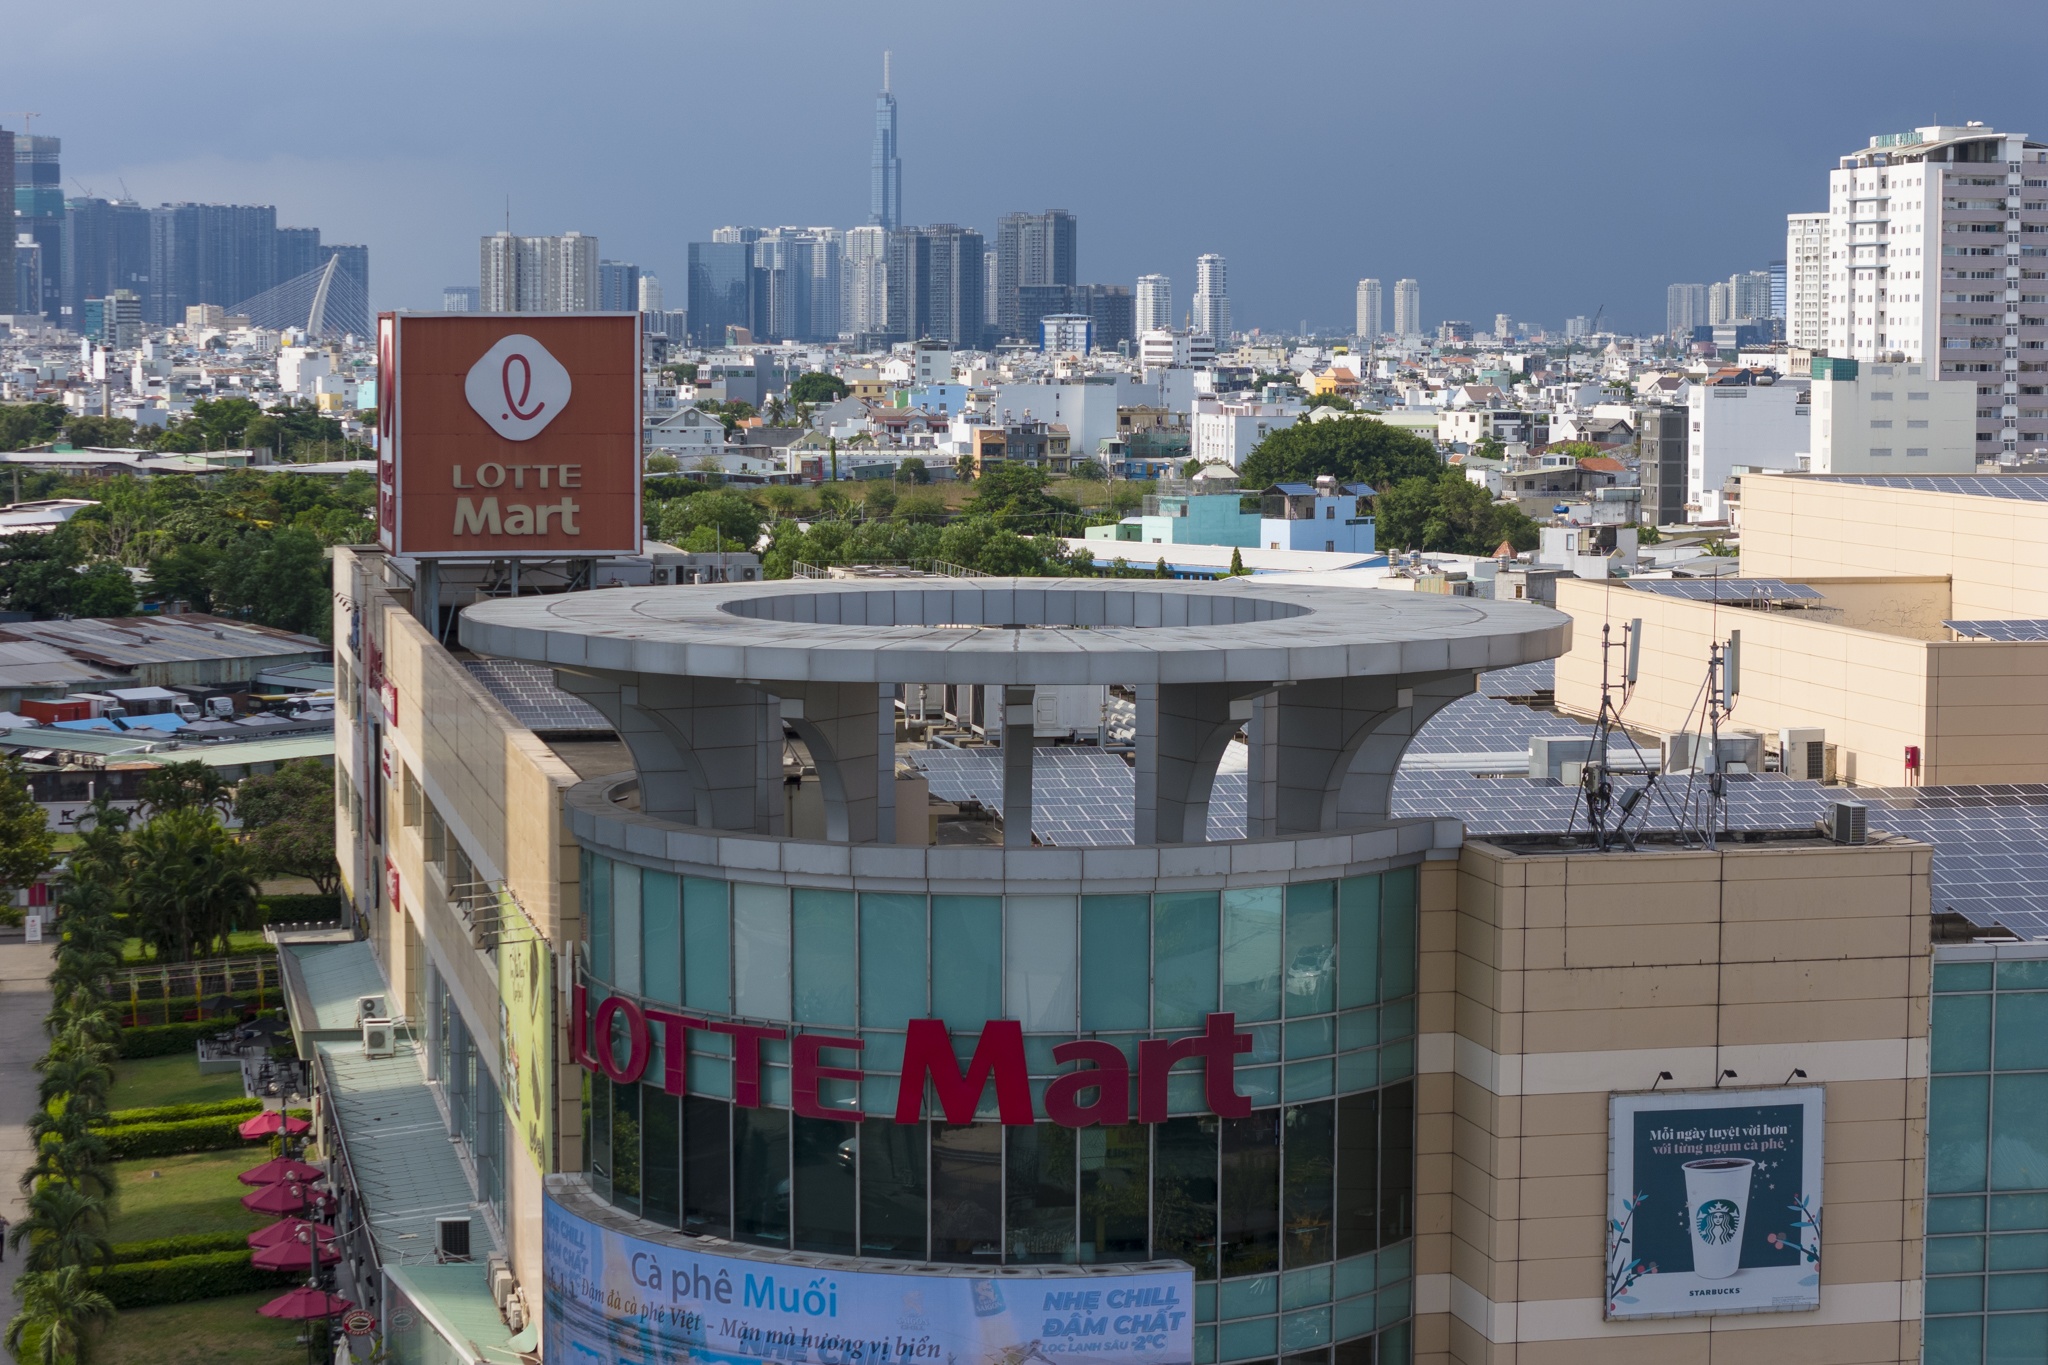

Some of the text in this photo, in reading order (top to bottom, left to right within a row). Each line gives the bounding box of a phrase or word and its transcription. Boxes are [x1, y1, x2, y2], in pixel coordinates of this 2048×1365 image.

[452, 462, 582, 489] LOTTE
[452, 497, 581, 536] Mart
[573, 983, 1253, 1128] LOTTE Mart
[1649, 1123, 1788, 1141] Mỗi ngày tuyệt vời hơn
[1652, 1137, 1785, 1156] với từng ngụm cà phê
[631, 1252, 663, 1291] Cà
[671, 1263, 733, 1304] phê
[743, 1273, 837, 1318] Muối
[1689, 1287, 1741, 1297] STARBUCKS
[1042, 1286, 1180, 1315] NHẸ CHILL
[581, 1277, 605, 1305] Đậm
[607, 1289, 622, 1311] đà
[624, 1296, 638, 1316] cà
[640, 1301, 666, 1324] phê
[669, 1307, 702, 1335] Việt
[719, 1317, 760, 1345] Mặn
[766, 1326, 796, 1346] mà
[801, 1327, 866, 1359] hương
[868, 1336, 890, 1361] vị
[894, 1334, 942, 1359] biển
[1041, 1304, 1187, 1342] ĐẬM CHẤT
[1103, 1340, 1129, 1351] SÂU
